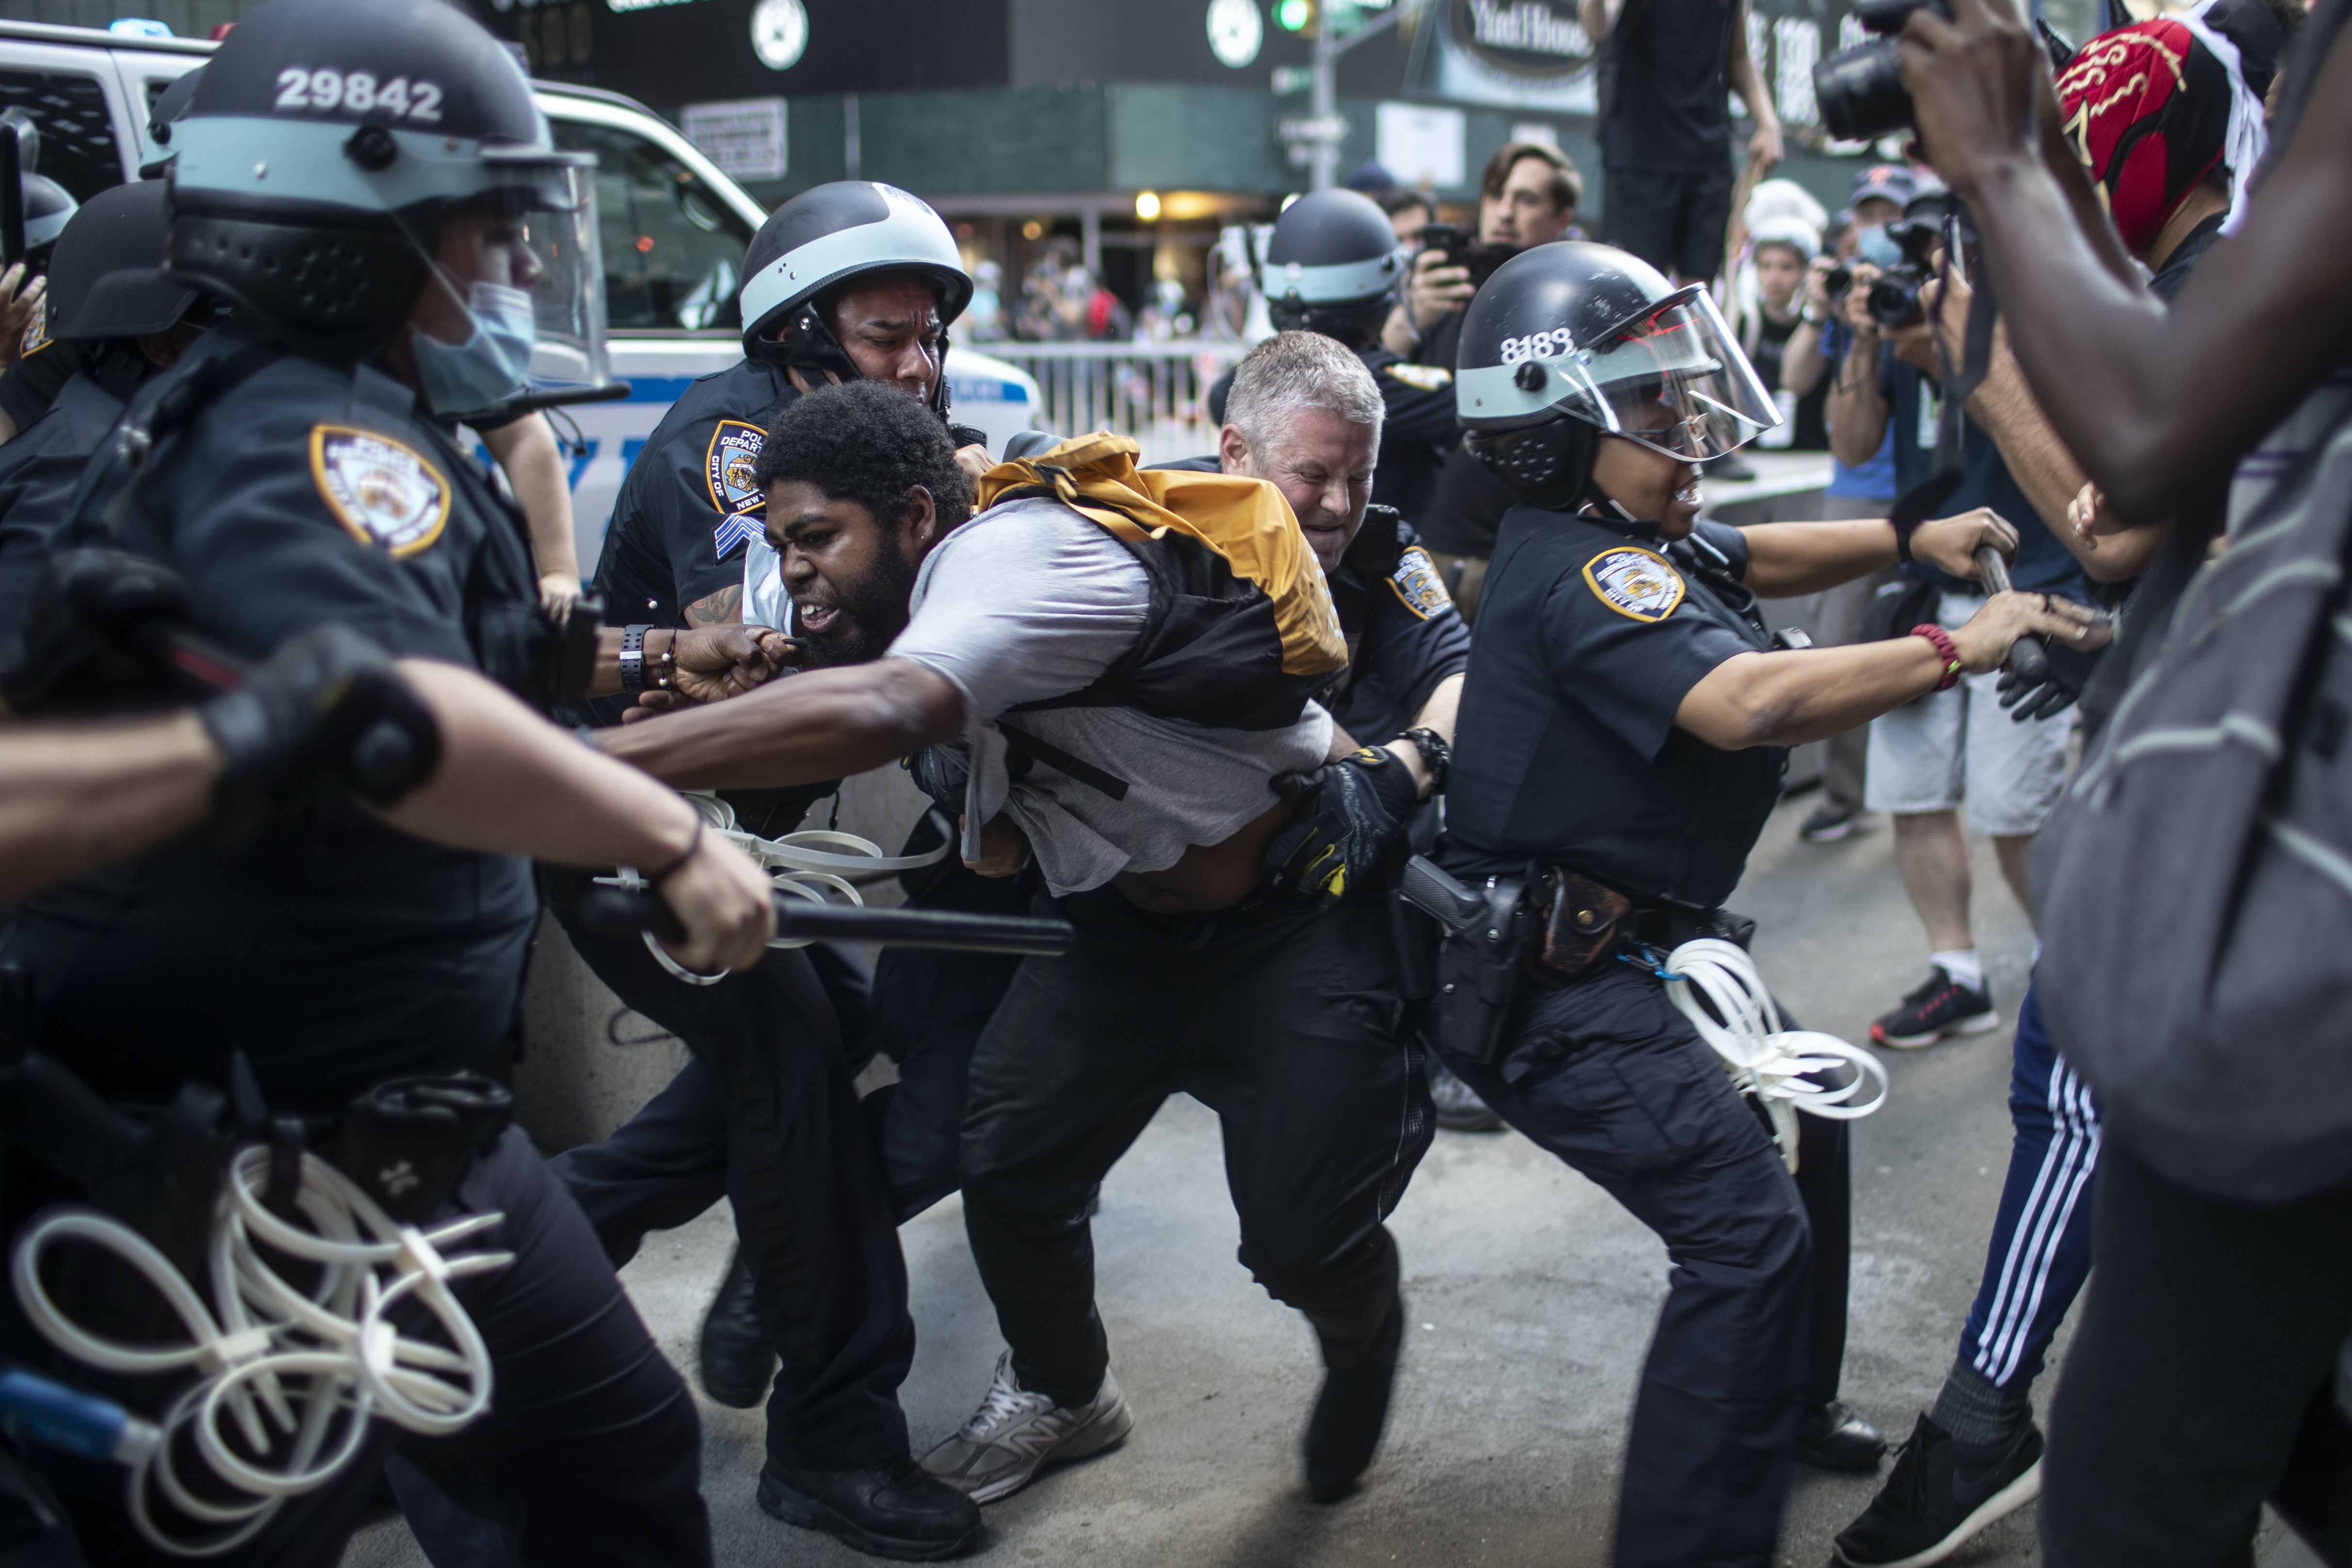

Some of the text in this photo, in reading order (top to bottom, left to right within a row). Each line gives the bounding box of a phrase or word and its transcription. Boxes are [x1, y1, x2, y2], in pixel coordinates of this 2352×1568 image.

[275, 68, 443, 122] 29842
[741, 430, 764, 446] POL
[711, 455, 724, 497] CITY OF
[737, 496, 759, 510] NEW
